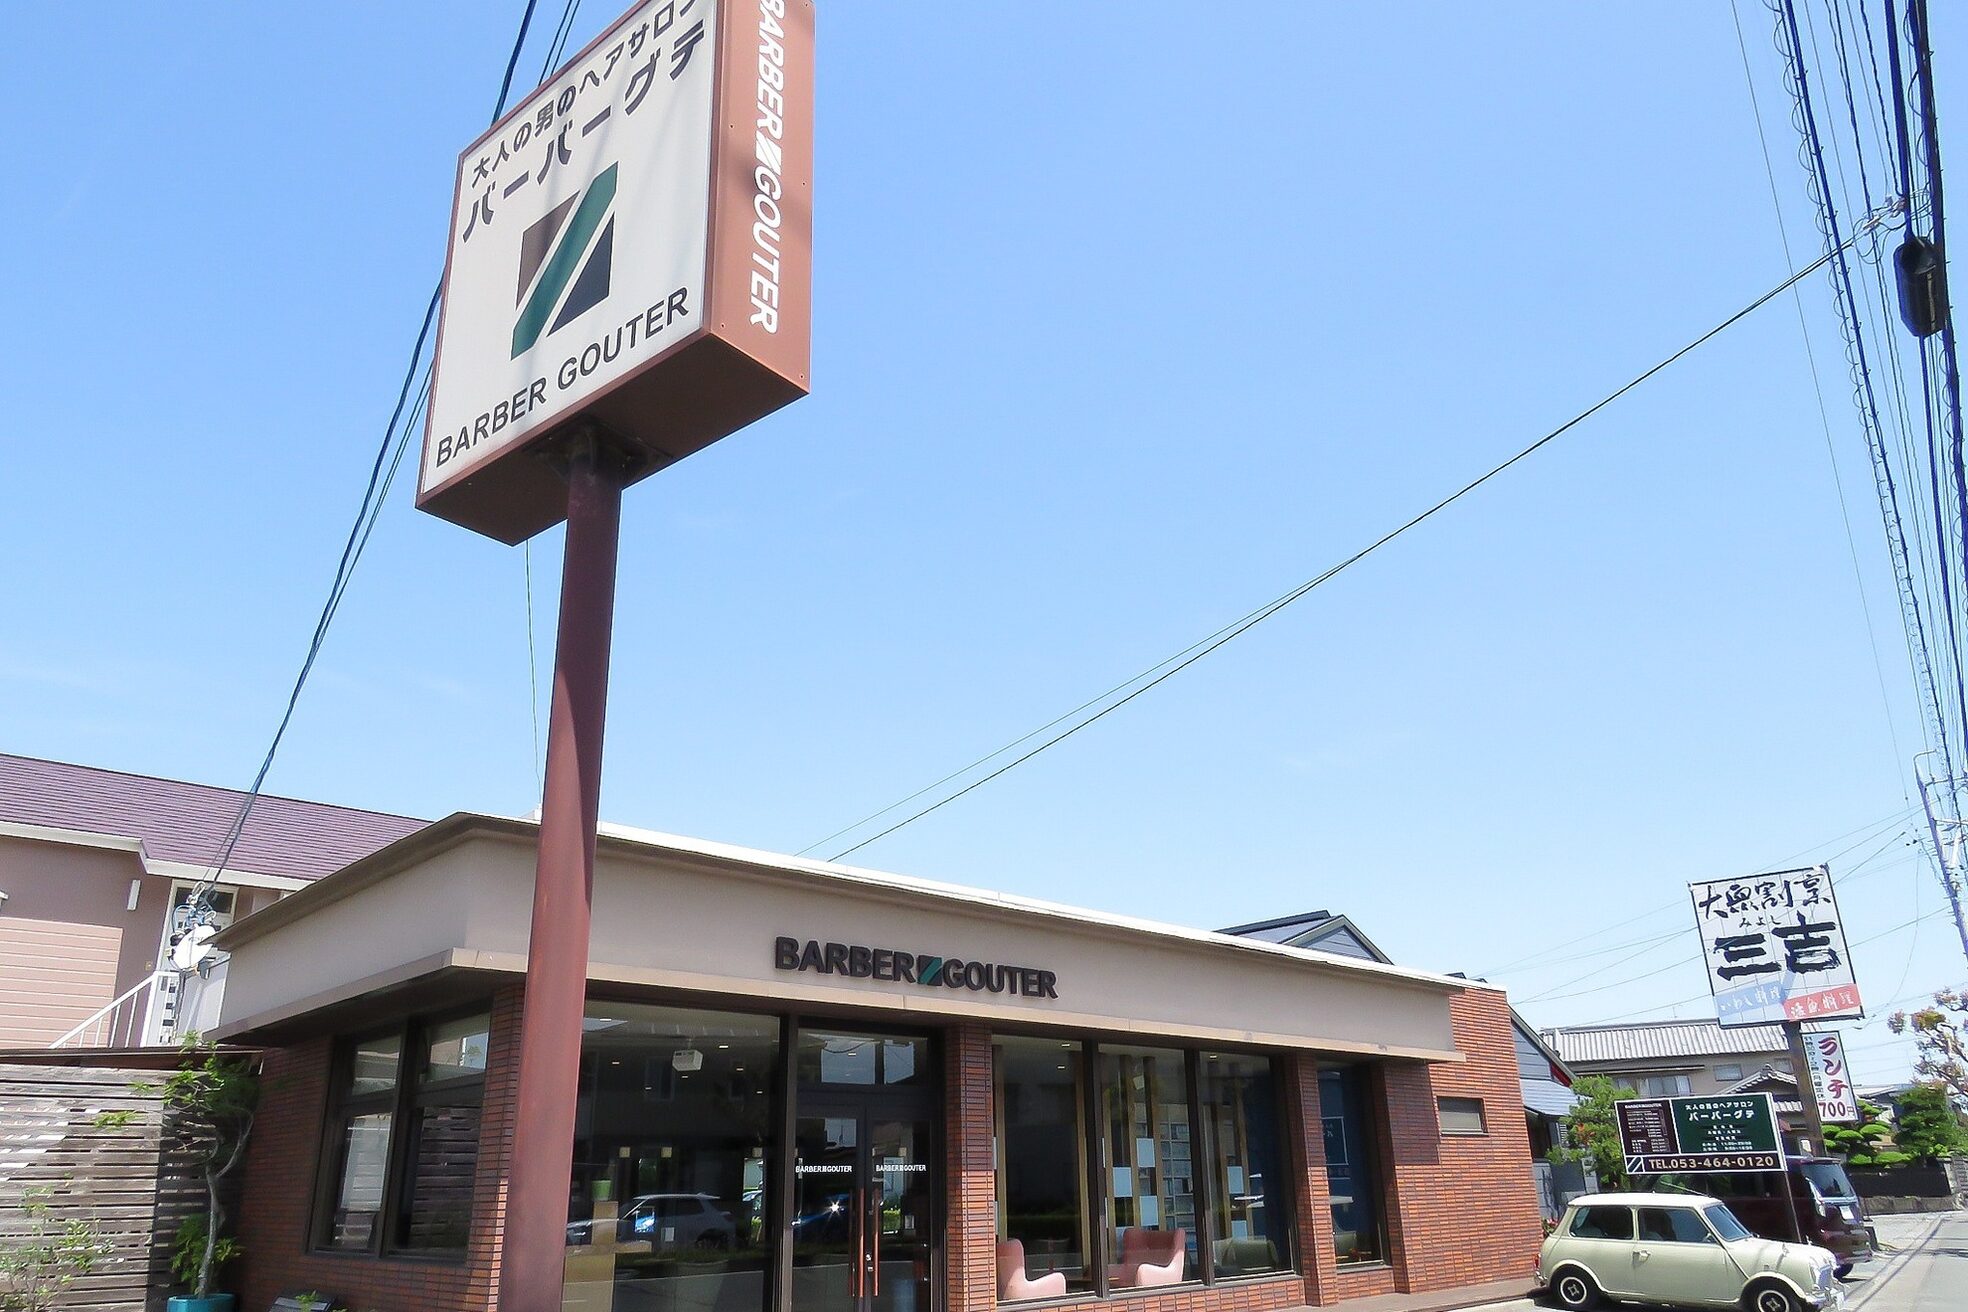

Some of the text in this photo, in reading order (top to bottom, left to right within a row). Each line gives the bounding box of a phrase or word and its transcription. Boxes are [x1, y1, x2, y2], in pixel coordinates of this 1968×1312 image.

[462, 19, 705, 243] バーバーグテ
[749, 165, 782, 335] GOUTER
[436, 286, 690, 468] BARBER GOUTER
[774, 936, 1059, 999] BARBER GOUTER
[1713, 910, 1842, 981] 三吉
[1818, 1036, 1849, 1099] ランチ
[795, 1165, 853, 1173] BARBER GOUTER
[904, 1164, 927, 1172] GOUTER
[1648, 1156, 1774, 1170] TEL.053-464-0120
